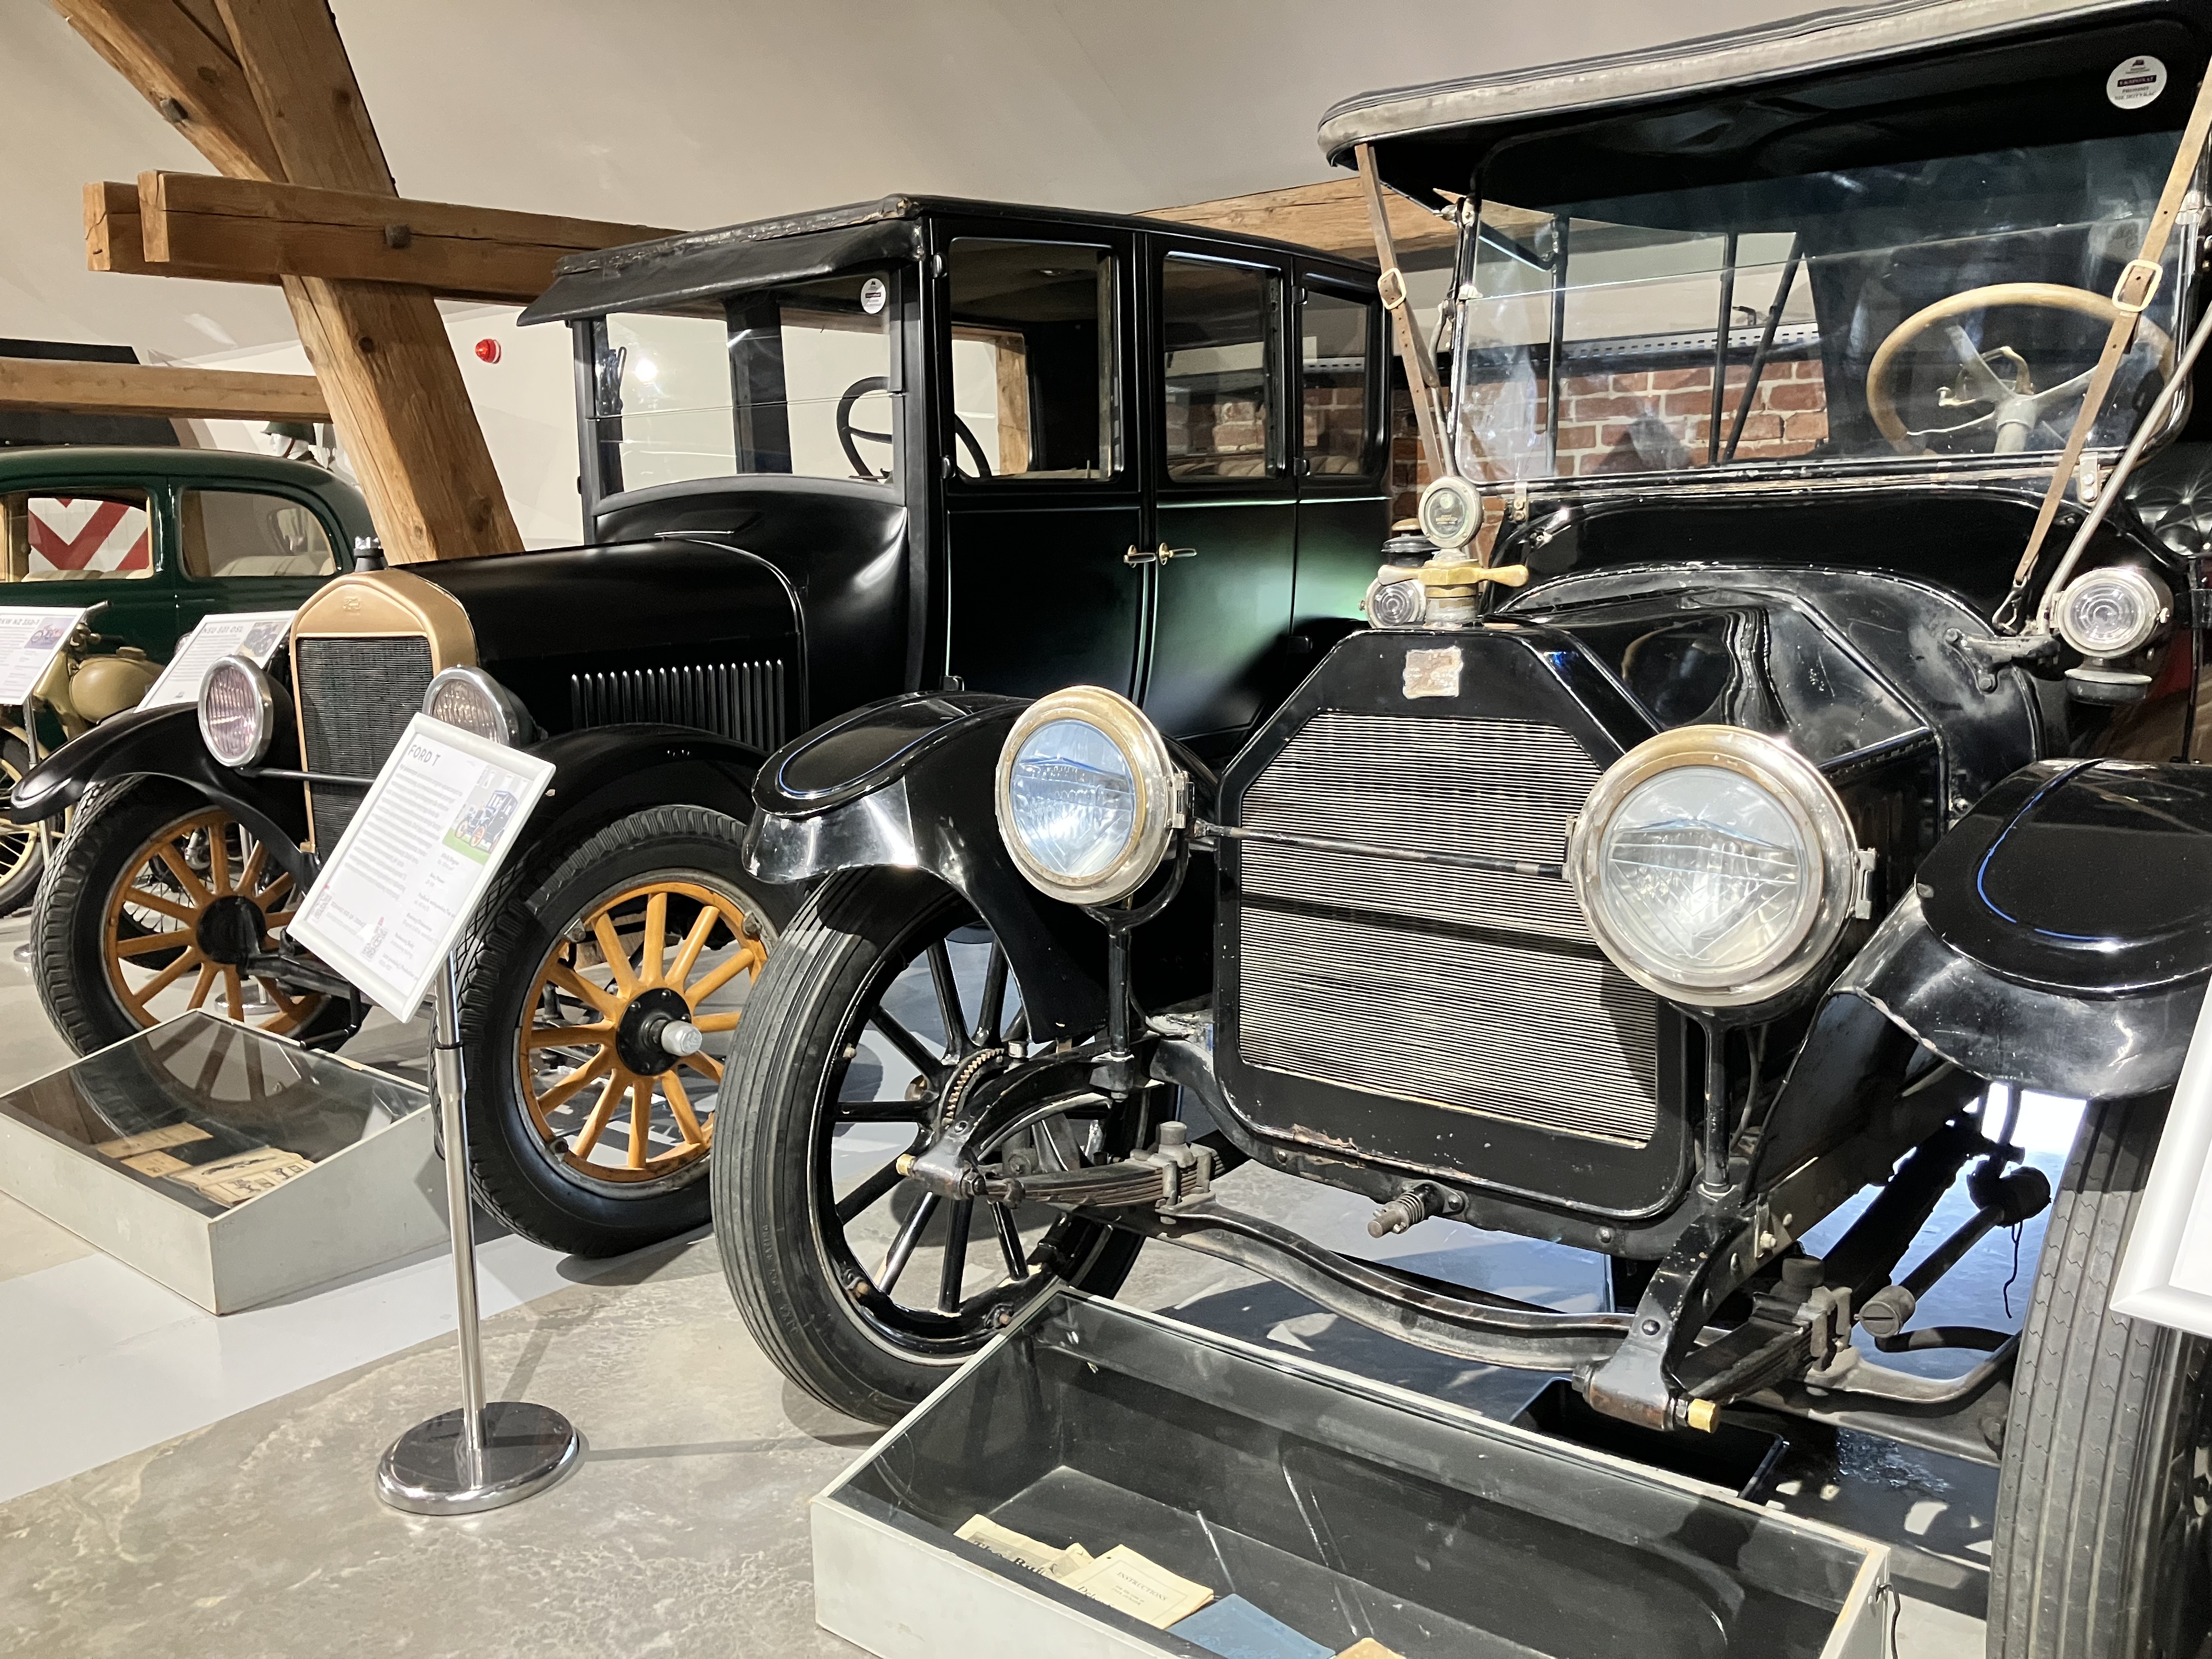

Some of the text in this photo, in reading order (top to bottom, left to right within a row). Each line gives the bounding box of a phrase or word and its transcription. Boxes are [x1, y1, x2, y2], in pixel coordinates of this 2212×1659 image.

[407, 744, 441, 766] FORD T
[1117, 1572, 1170, 1601] INSTRUCTIONS
